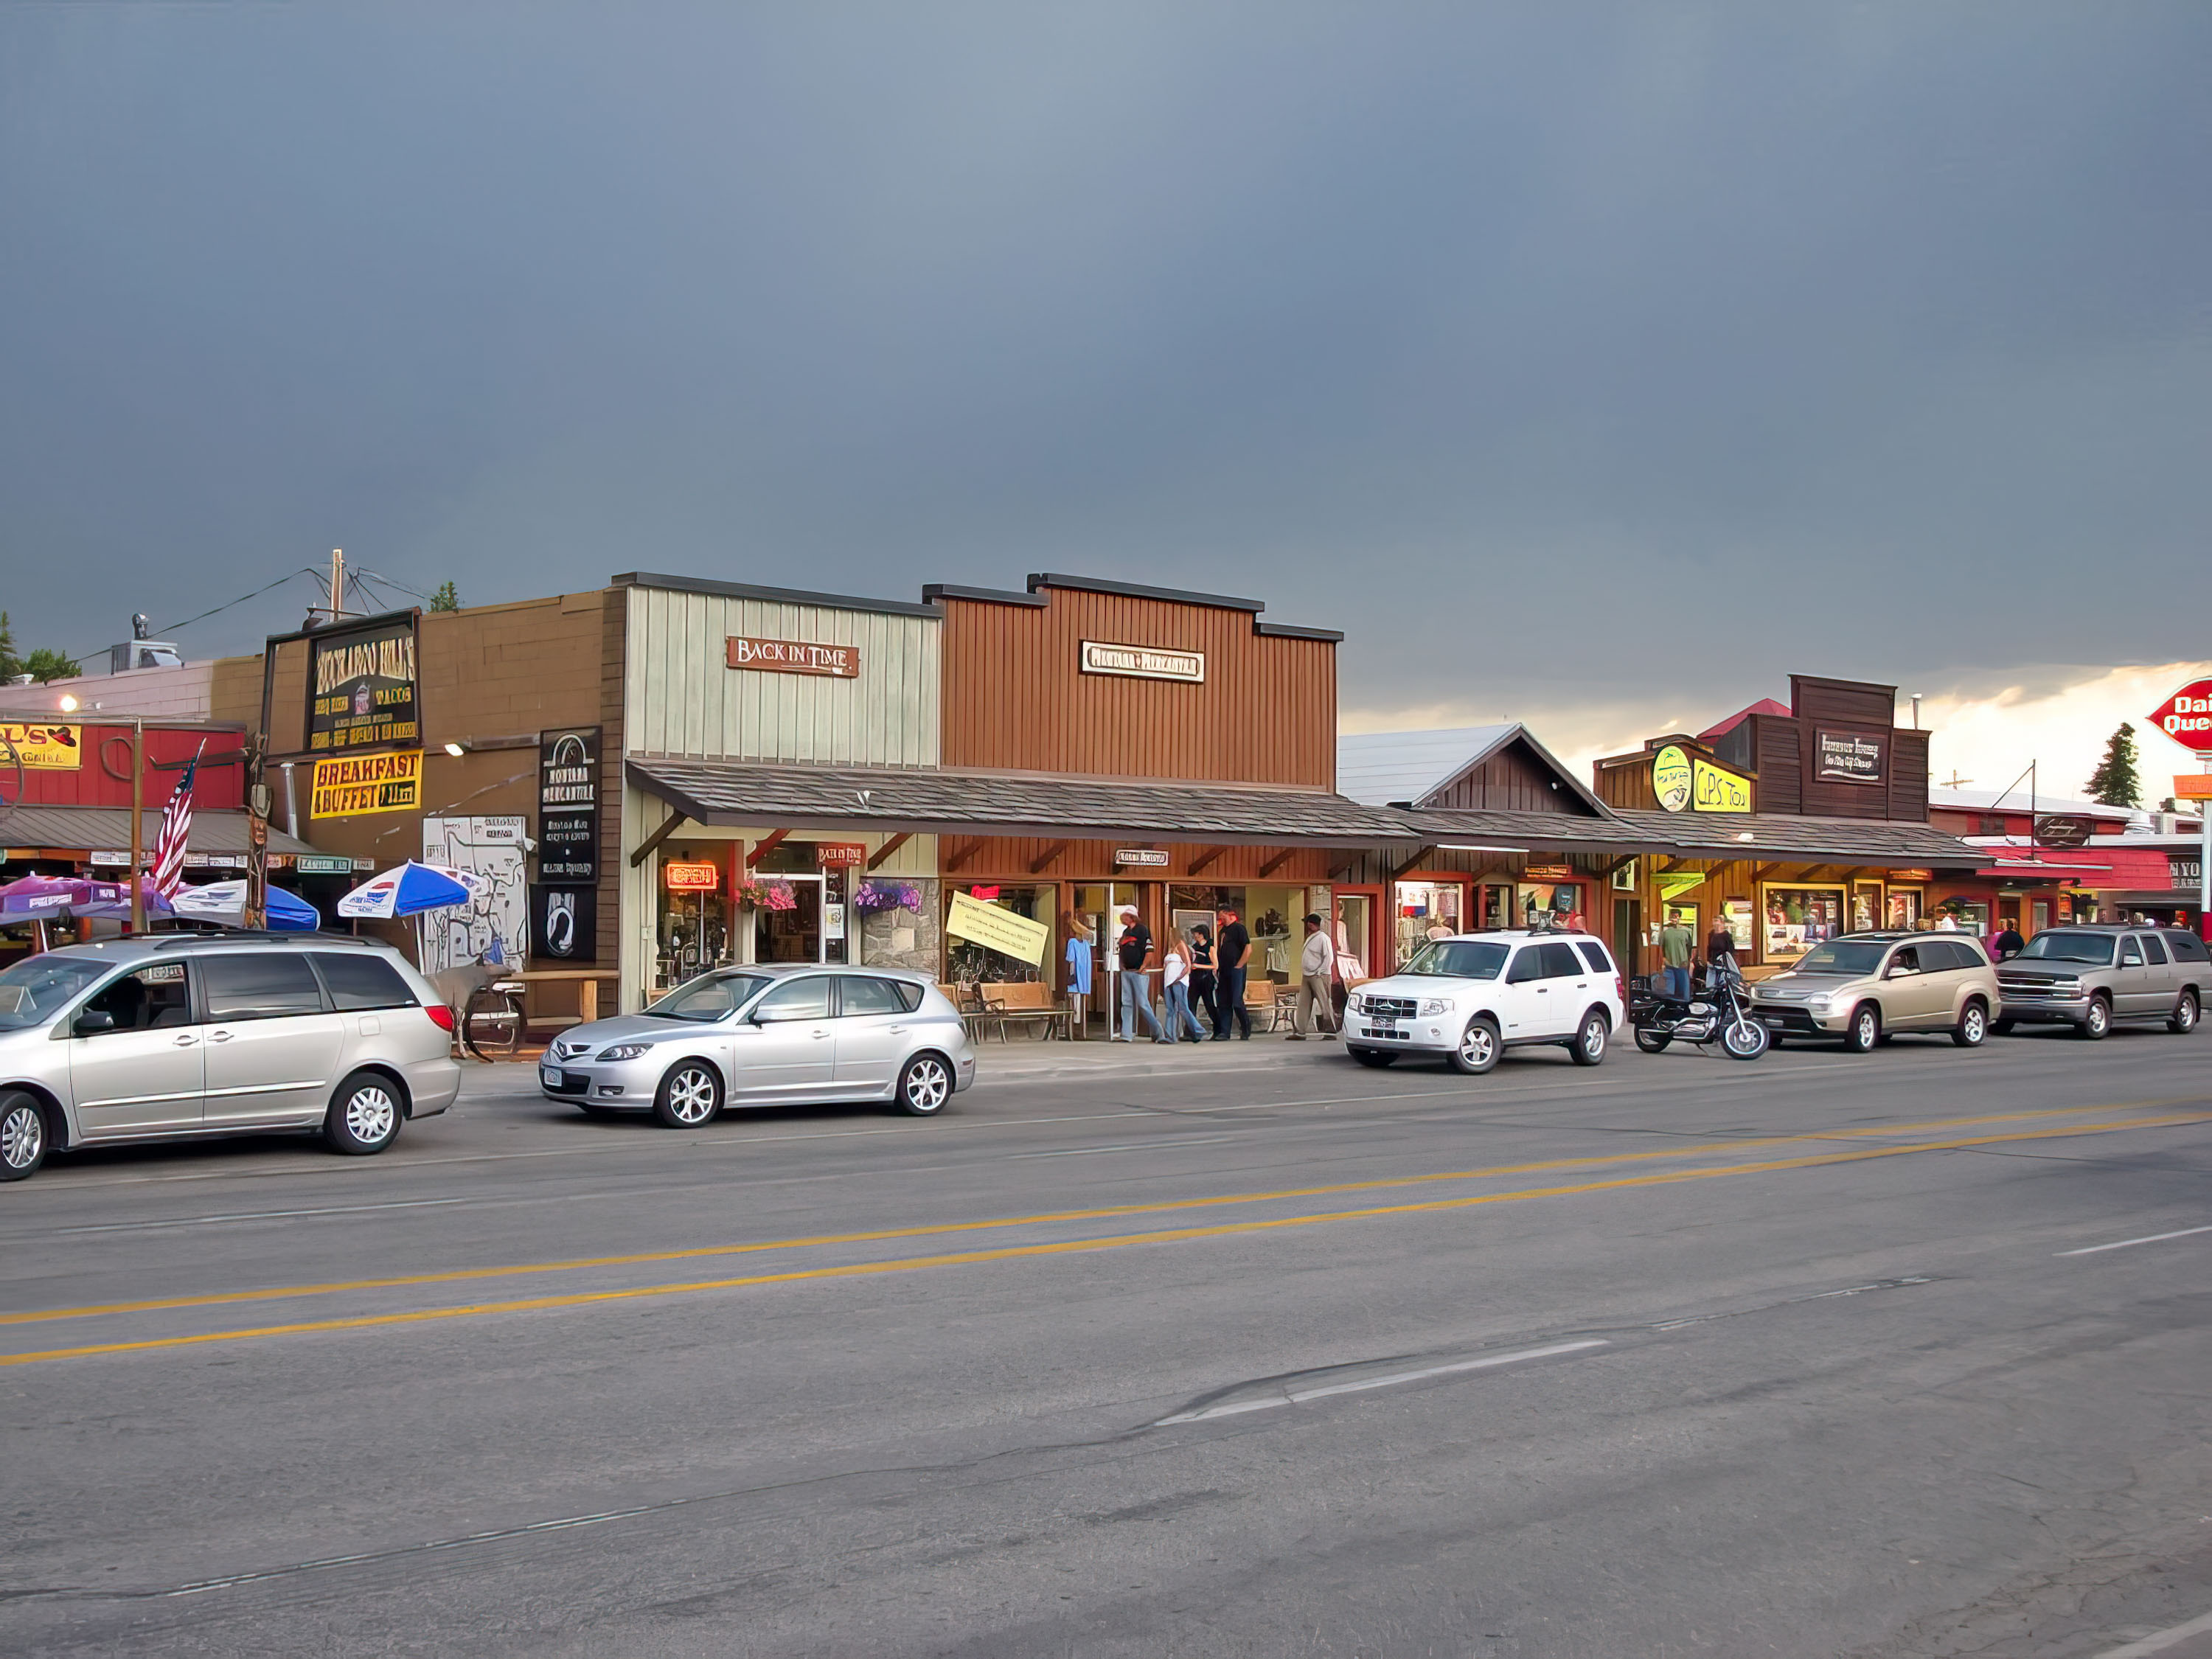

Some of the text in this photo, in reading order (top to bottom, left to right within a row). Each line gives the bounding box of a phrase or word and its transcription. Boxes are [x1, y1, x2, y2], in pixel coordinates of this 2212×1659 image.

[789, 645, 804, 661] IN
[2164, 715, 2212, 734] Que
[317, 754, 418, 787] BREAKFAST
[323, 785, 377, 812] BUFFET
